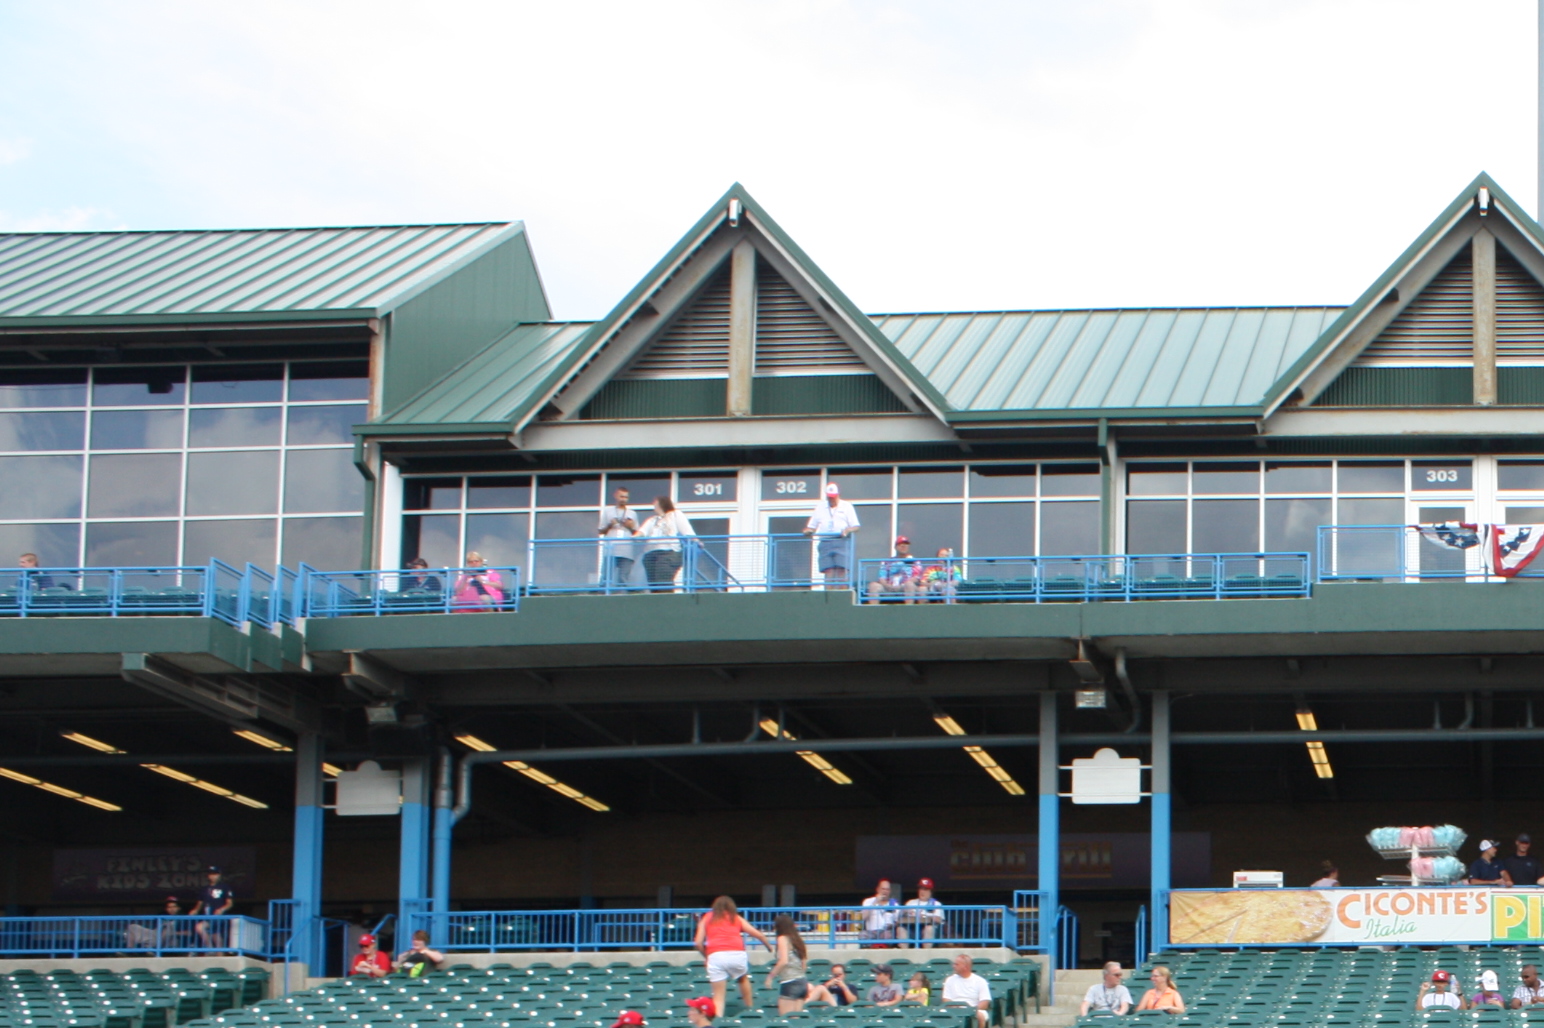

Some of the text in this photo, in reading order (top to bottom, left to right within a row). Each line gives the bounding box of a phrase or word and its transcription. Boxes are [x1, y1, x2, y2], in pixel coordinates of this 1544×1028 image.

[1426, 470, 1457, 482] 303
[694, 483, 722, 496] 301
[776, 482, 806, 494] 302
[97, 873, 150, 889] KIDS
[1337, 892, 1487, 929] CICONTE'S
[1364, 916, 1417, 939] Italia
